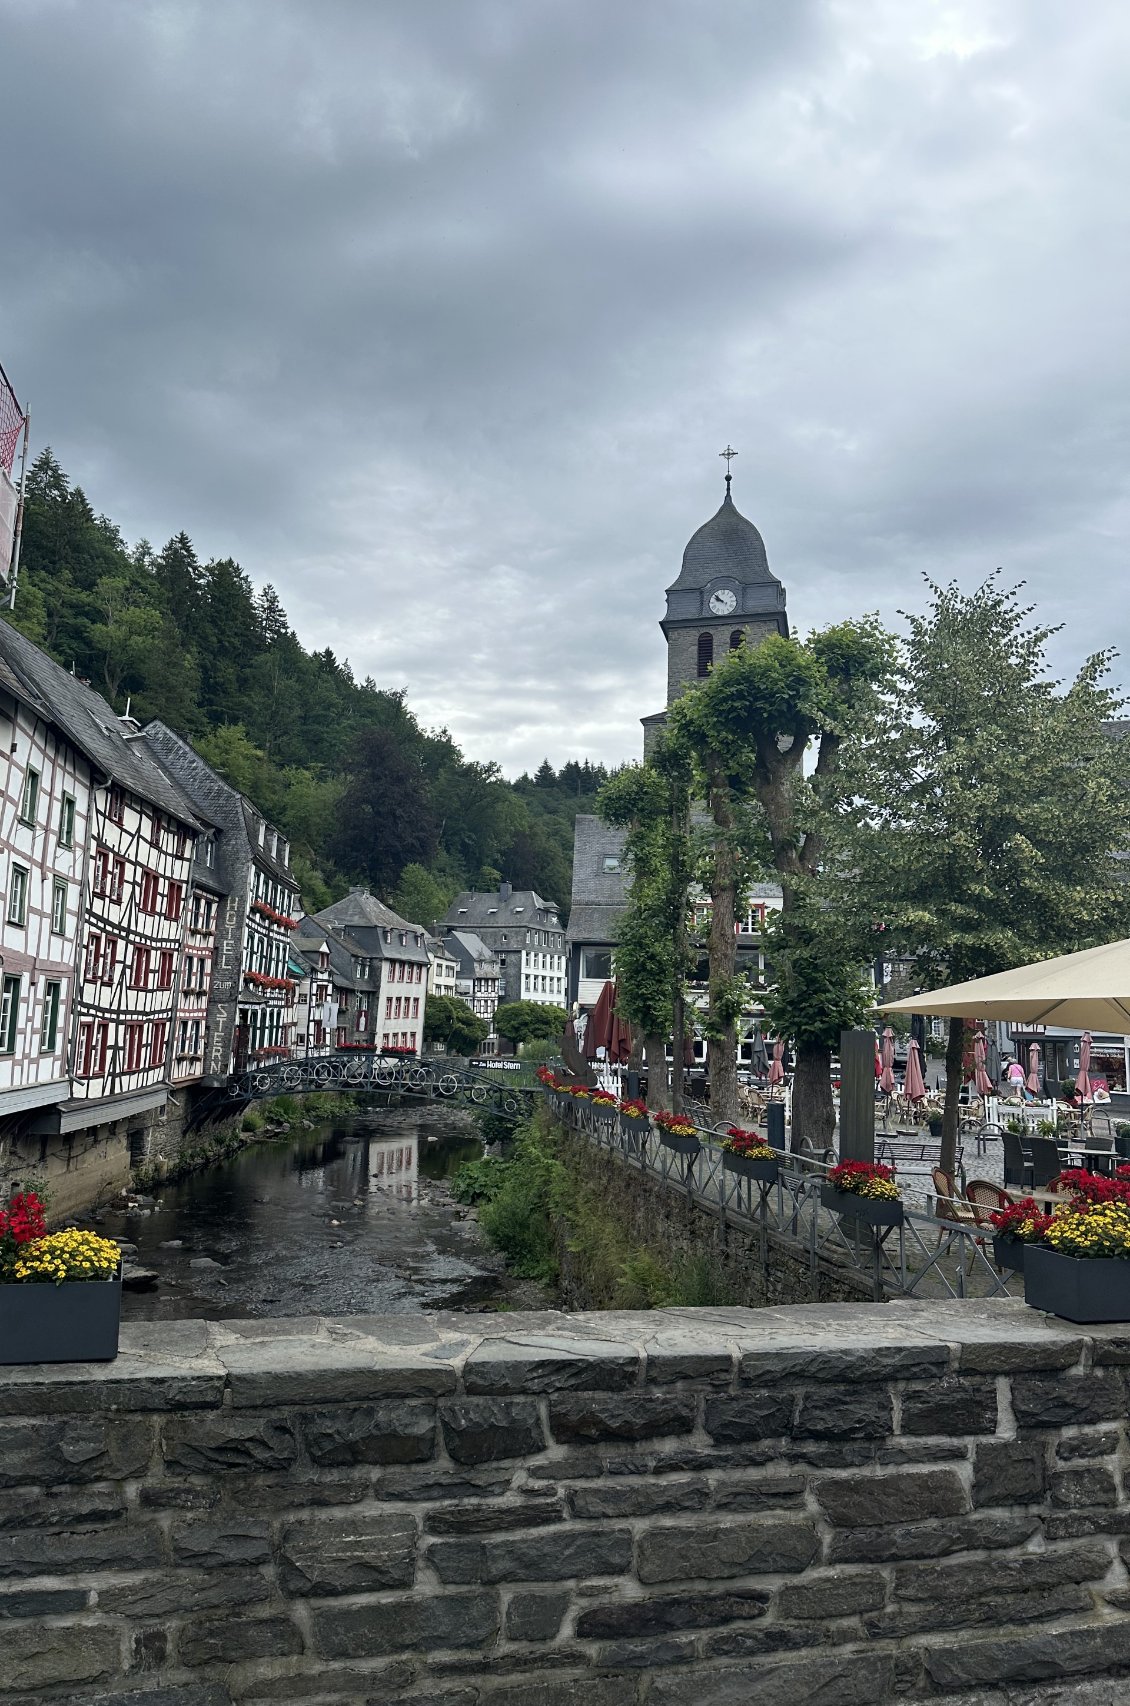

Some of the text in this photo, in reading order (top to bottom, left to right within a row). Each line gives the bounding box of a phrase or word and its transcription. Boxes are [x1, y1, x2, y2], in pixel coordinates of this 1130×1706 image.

[222, 896, 239, 969] HOTEL
[210, 1003, 229, 1075] STERN
[486, 1060, 503, 1069] Hotel
[503, 1061, 521, 1070] Stern
